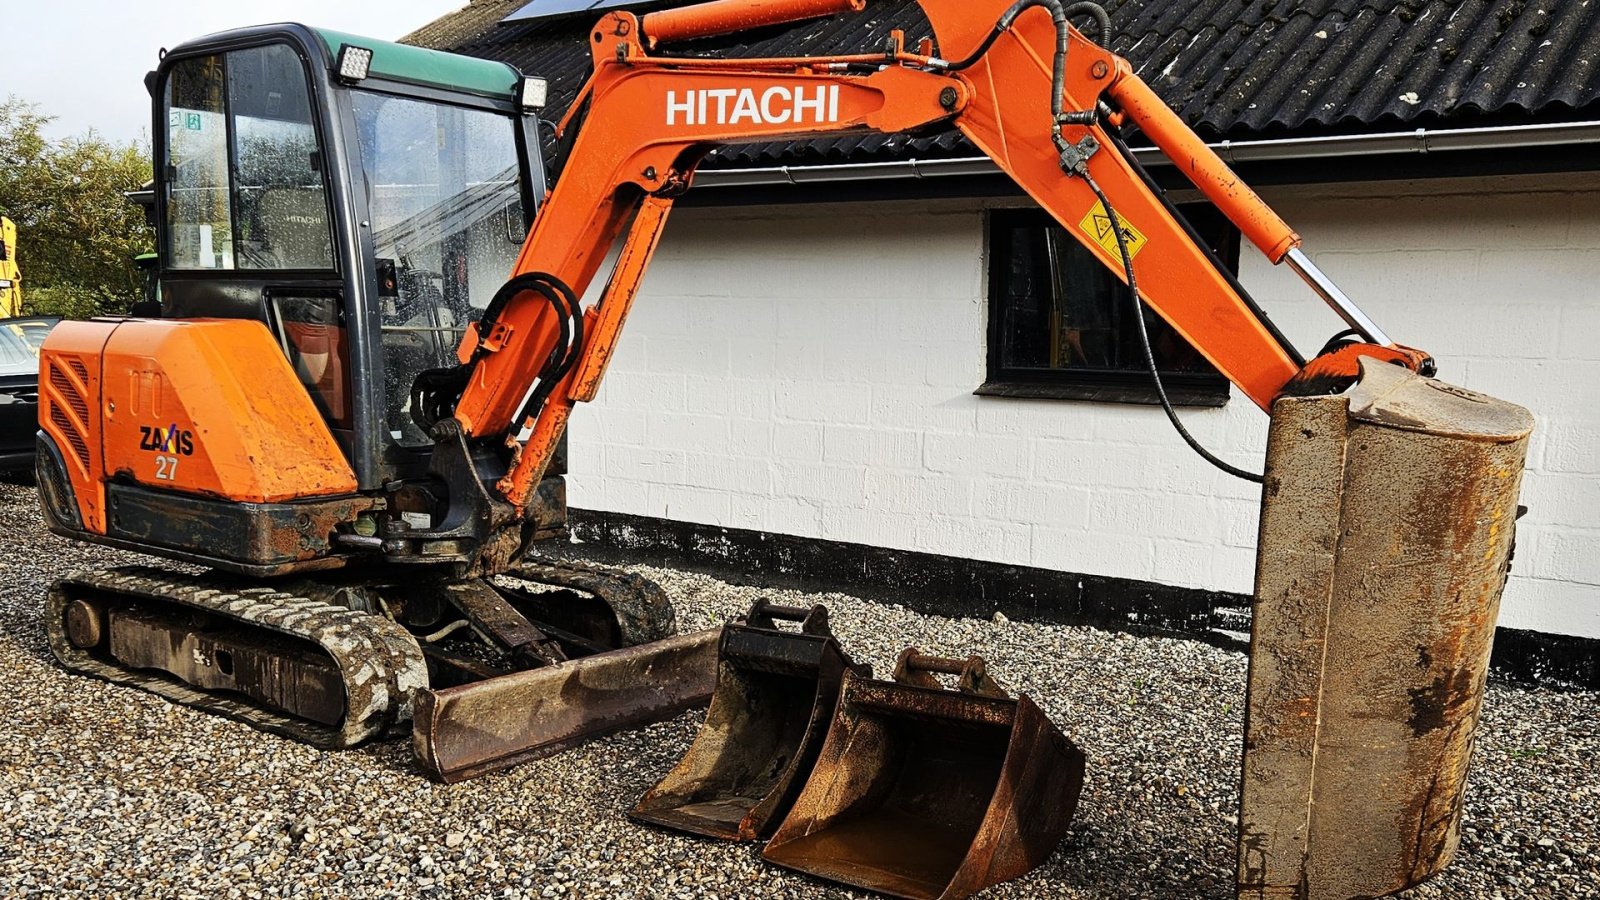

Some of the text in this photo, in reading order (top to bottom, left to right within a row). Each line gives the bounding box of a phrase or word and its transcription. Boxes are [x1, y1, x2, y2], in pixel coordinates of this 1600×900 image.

[666, 85, 839, 125] HITACHI
[140, 423, 194, 456] ZAXIS
[155, 456, 178, 480] 27
